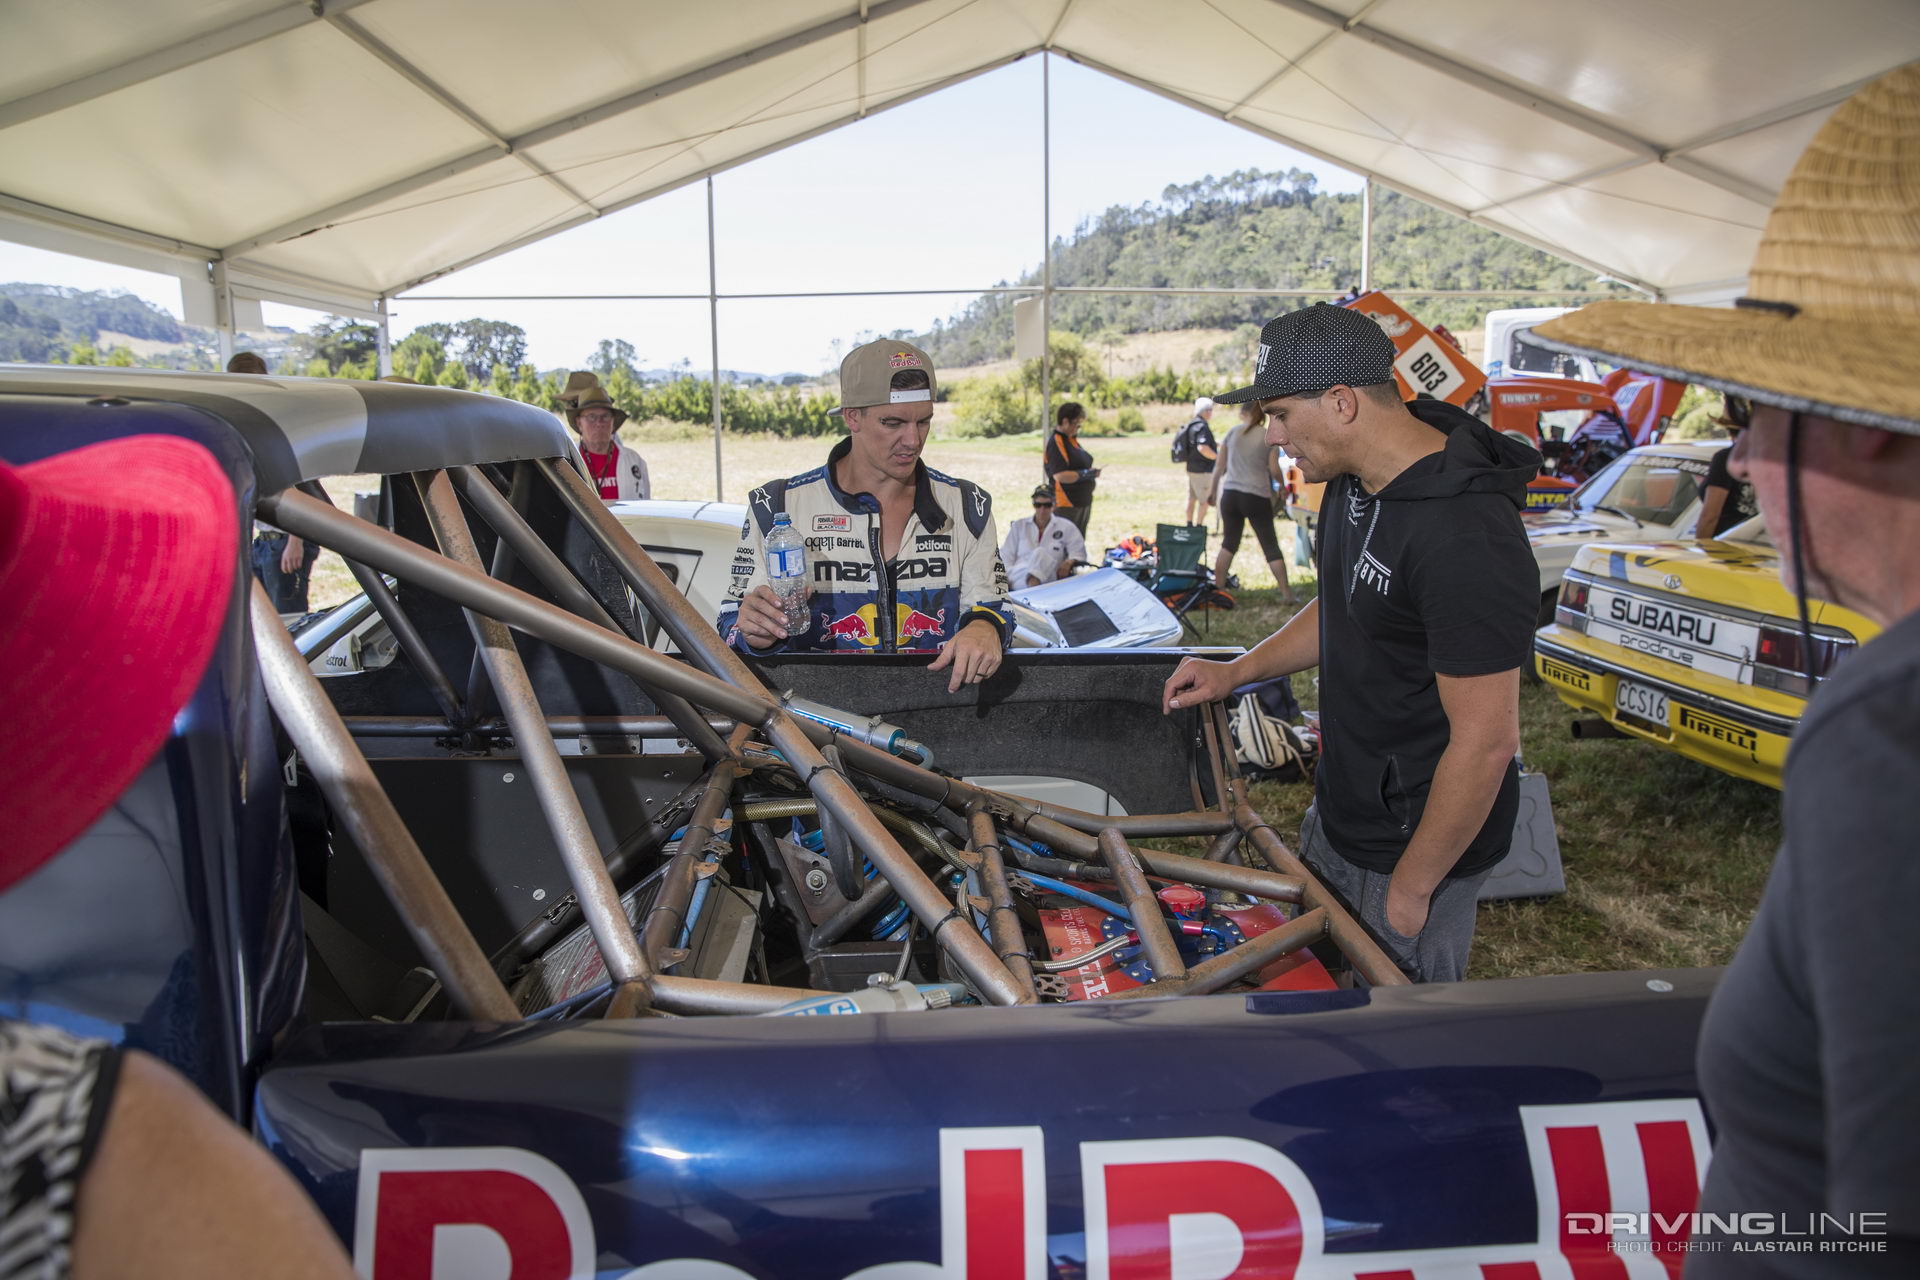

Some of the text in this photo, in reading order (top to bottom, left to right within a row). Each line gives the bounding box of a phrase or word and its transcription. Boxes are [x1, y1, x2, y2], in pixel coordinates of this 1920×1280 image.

[1410, 352, 1448, 392] 603
[1611, 597, 1716, 645] SUBARU
[1620, 634, 1694, 664] prodrive
[1542, 657, 1590, 691] PIRELLI
[1618, 680, 1666, 720] CCS16
[1680, 707, 1757, 751] PIRELLI
